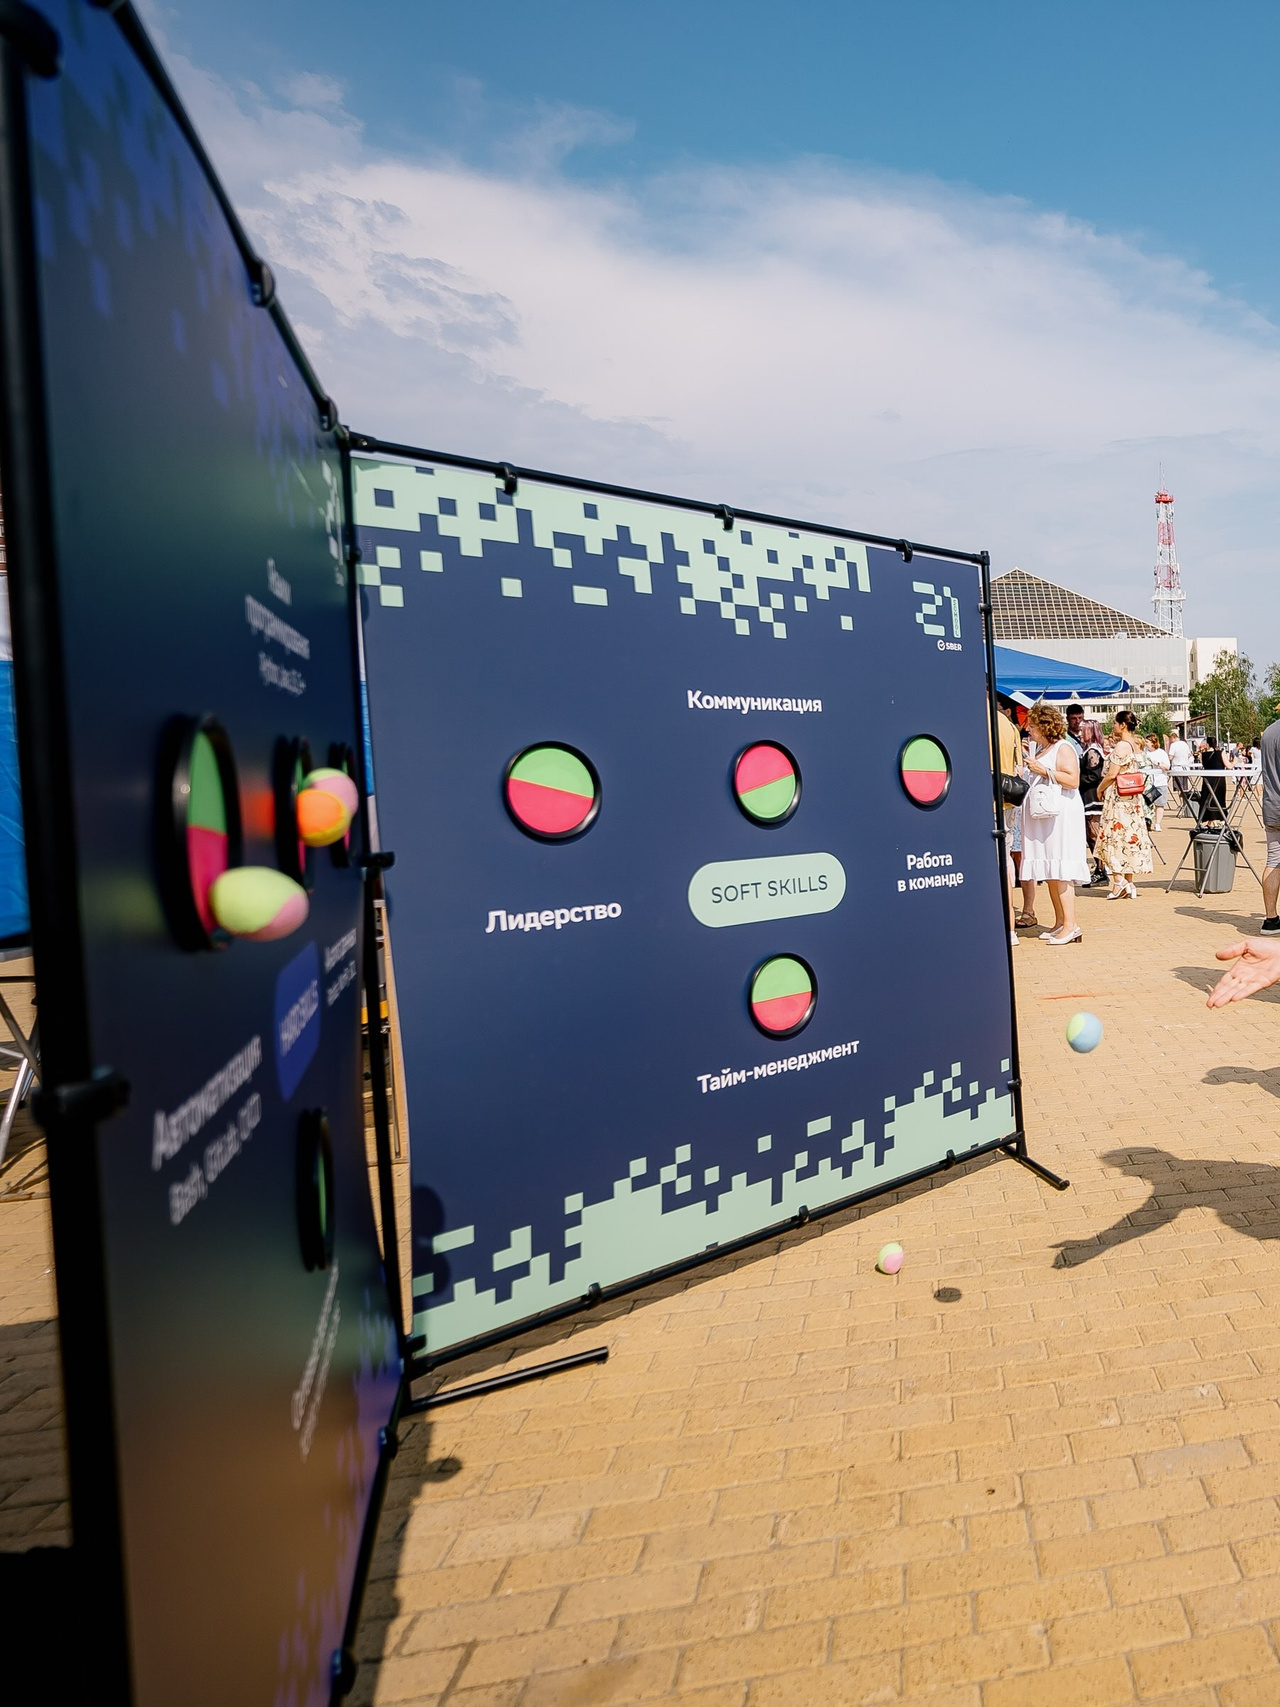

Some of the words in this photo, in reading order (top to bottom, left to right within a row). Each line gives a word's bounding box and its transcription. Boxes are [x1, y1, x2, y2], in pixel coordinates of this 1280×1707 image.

[912, 581, 961, 638] 21
[946, 642, 962, 651] SBER
[686, 689, 823, 715] Коммуникация
[906, 851, 953, 871] Работа
[711, 882, 762, 904] SOFT
[768, 875, 828, 897] SKILLS
[897, 879, 907, 893] в
[909, 872, 964, 891] команде
[485, 902, 622, 934] Лидерство
[696, 1040, 860, 1094] Тайм-менеджмент
